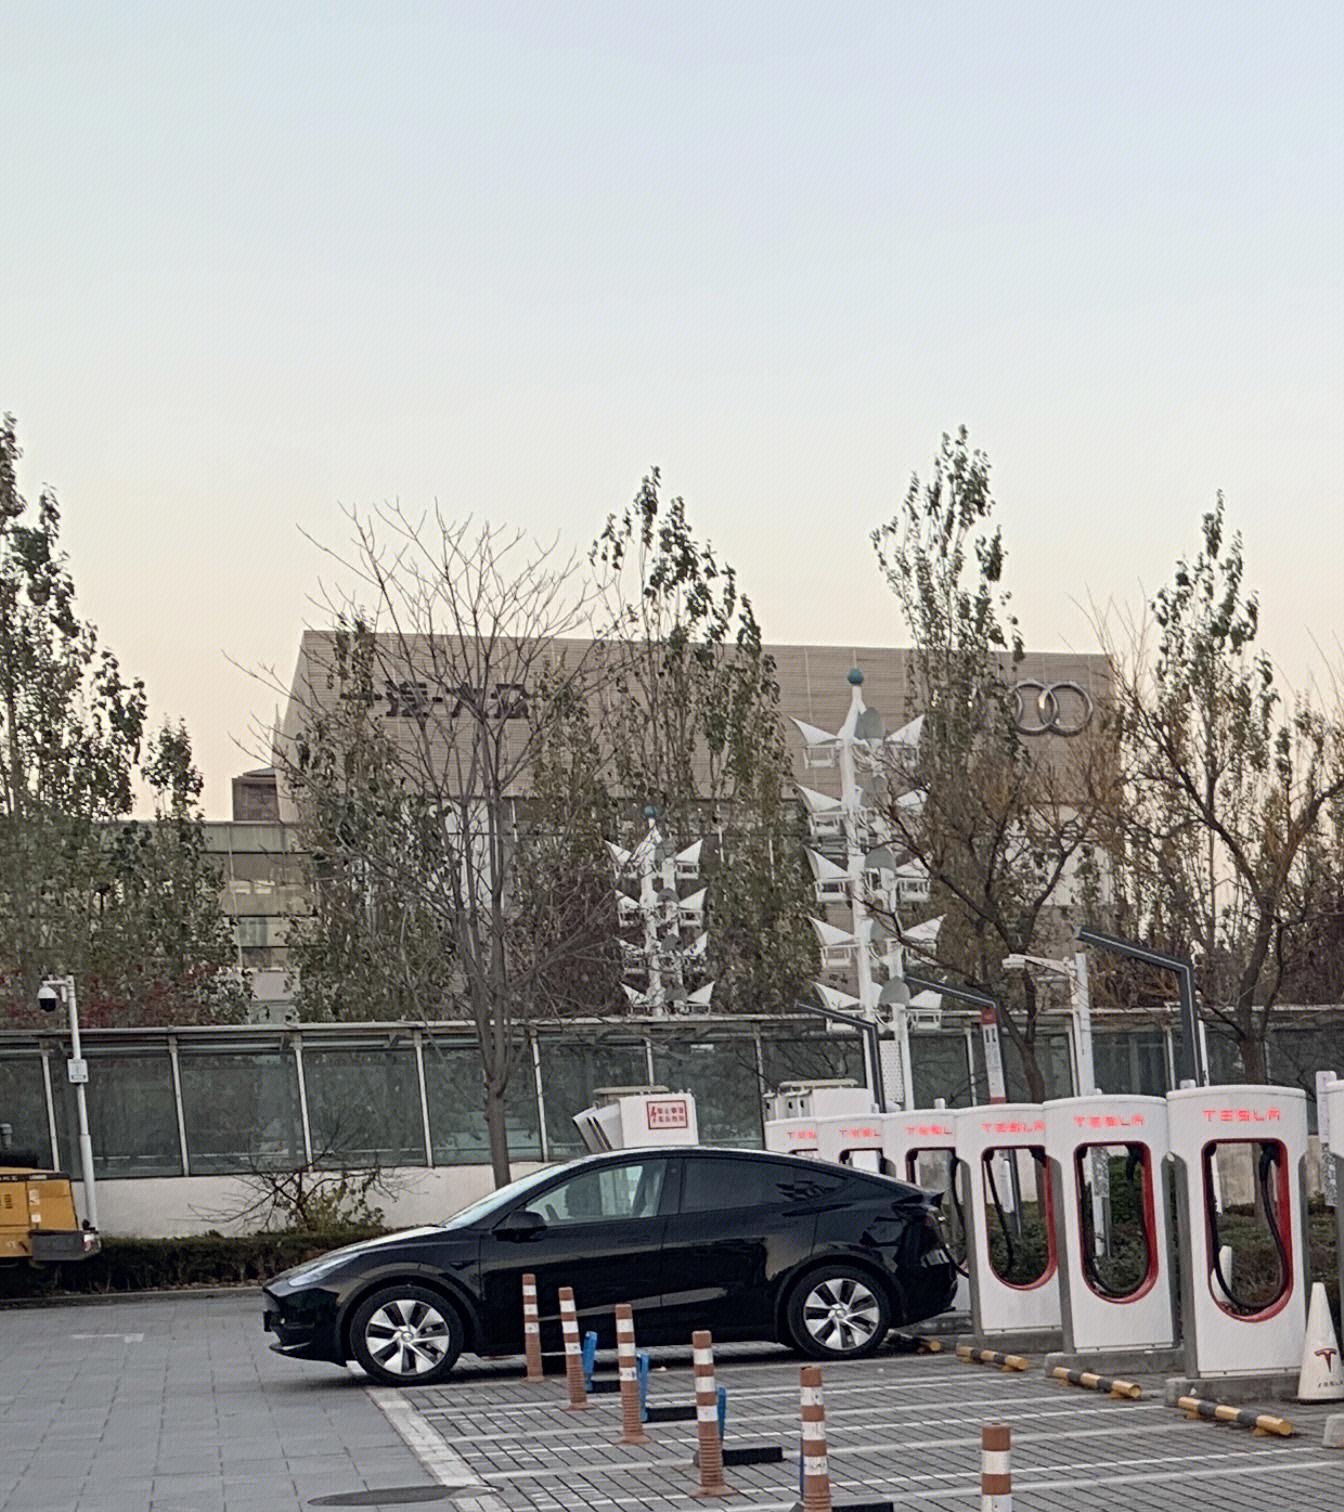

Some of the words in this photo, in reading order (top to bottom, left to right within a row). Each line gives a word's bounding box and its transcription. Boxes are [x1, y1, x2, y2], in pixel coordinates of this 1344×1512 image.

[1073, 1114, 1144, 1127] TESLA
[1202, 1108, 1280, 1122] TESLA
[906, 1125, 952, 1135] TESL
[981, 1121, 1045, 1133] TESLA
